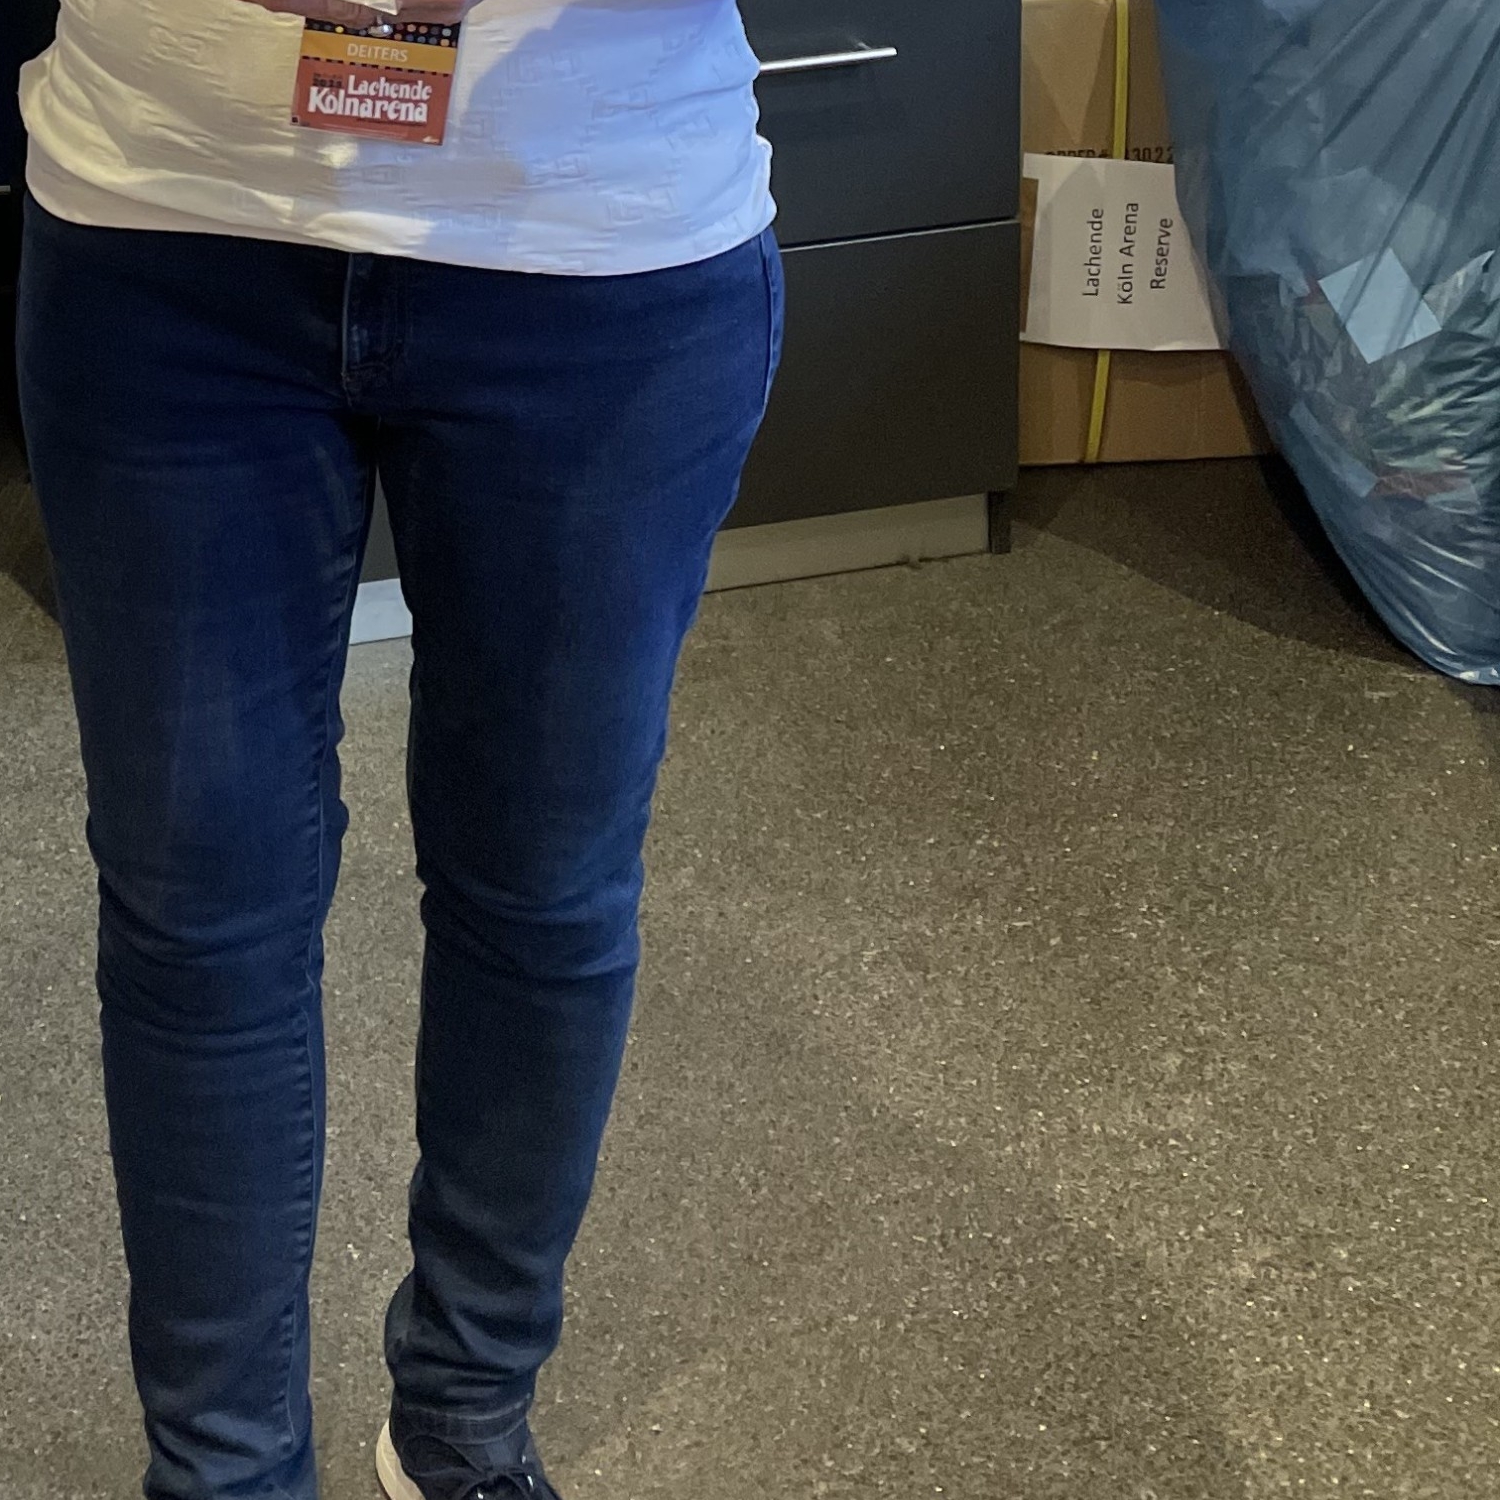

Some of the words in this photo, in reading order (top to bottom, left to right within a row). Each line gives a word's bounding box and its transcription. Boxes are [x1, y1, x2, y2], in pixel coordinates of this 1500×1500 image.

[347, 43, 408, 63] DEITERS
[307, 86, 428, 122] Kölnarena
[348, 74, 433, 101] Lachende
[1119, 202, 1139, 257] Arena
[1082, 208, 1105, 297] Lachende
[1150, 217, 1174, 290] Reserve
[1116, 263, 1134, 305] Köln
